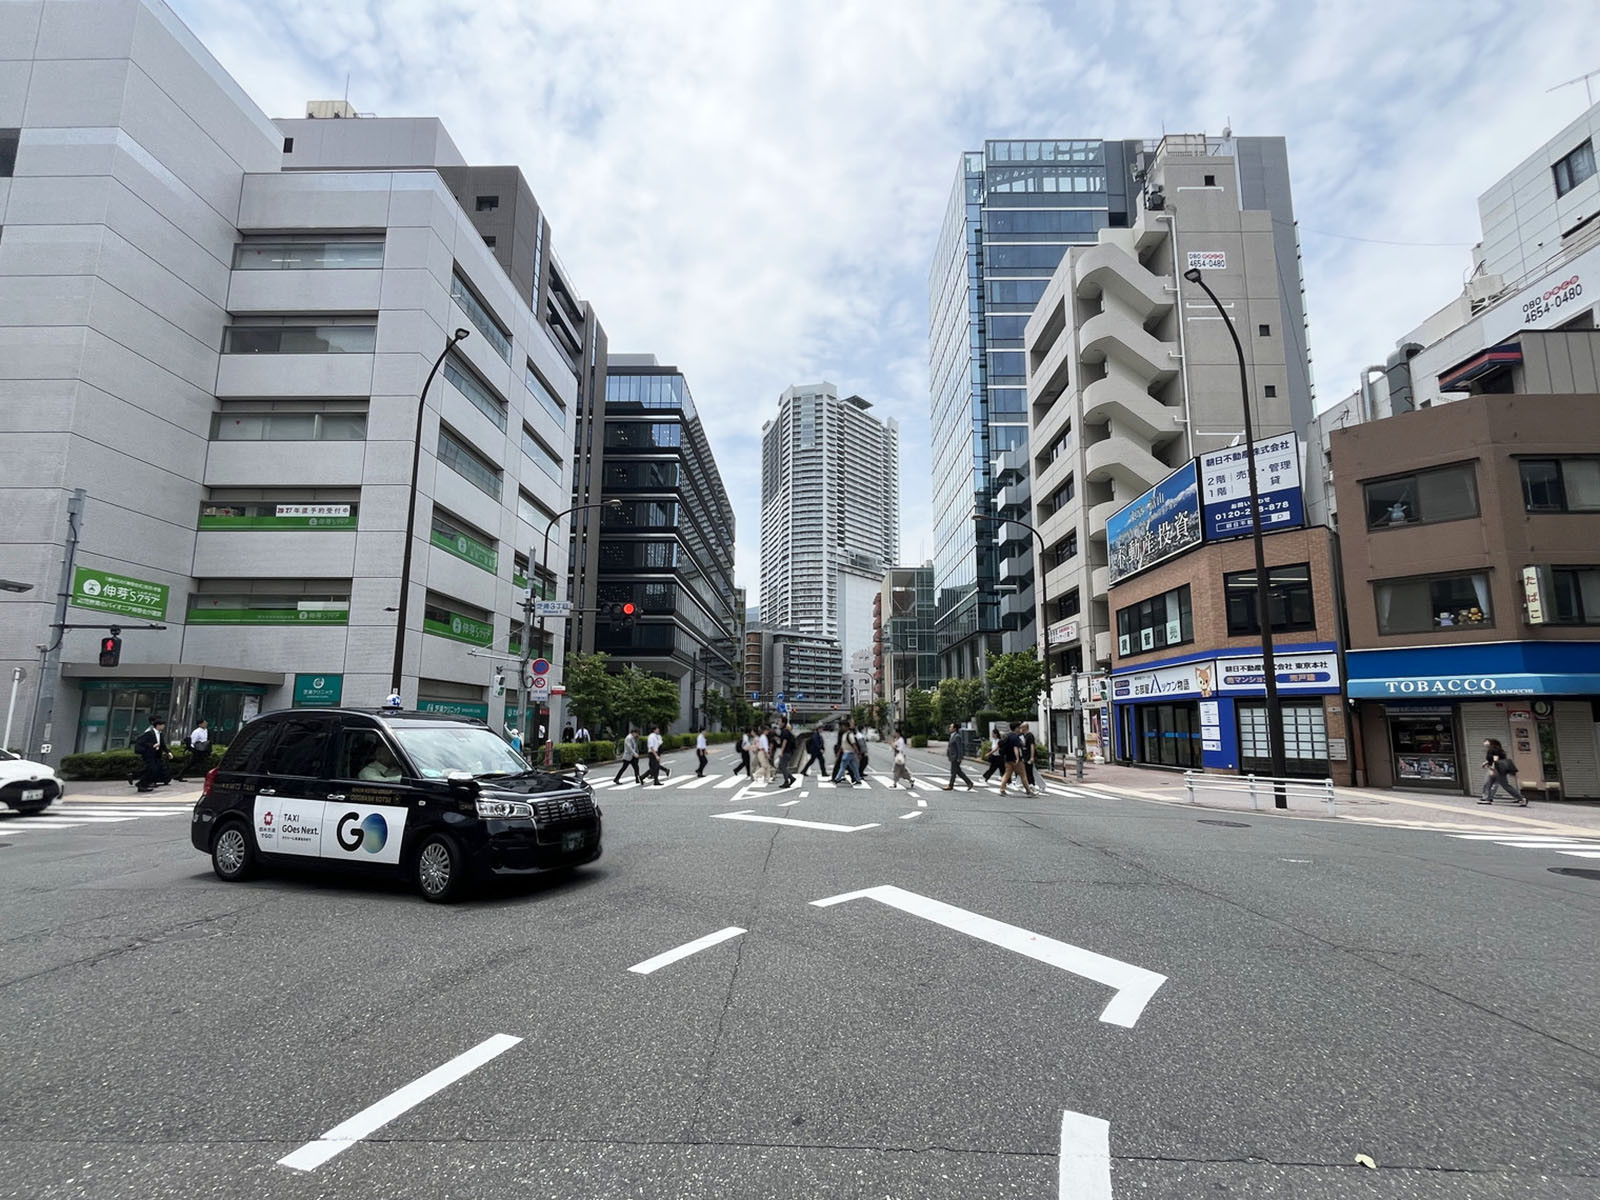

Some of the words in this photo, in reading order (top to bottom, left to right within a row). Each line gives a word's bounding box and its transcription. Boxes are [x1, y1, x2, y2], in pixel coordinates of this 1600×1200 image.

[1190, 259, 1225, 268] 4654-0480
[1524, 283, 1583, 323] 4654-0480
[1231, 497, 1271, 510] お問いわせ
[1215, 501, 1290, 520] 0120-28-878
[1226, 519, 1254, 529] 朝日不動
[1116, 510, 1190, 570] 不動産投資
[1525, 576, 1541, 620] たばこ
[1225, 663, 1293, 672] 朝日不動産会社
[1385, 678, 1497, 693] TOBACCO
[283, 813, 300, 822] TAXI
[281, 824, 300, 834] GOes
[301, 826, 319, 836] Next.
